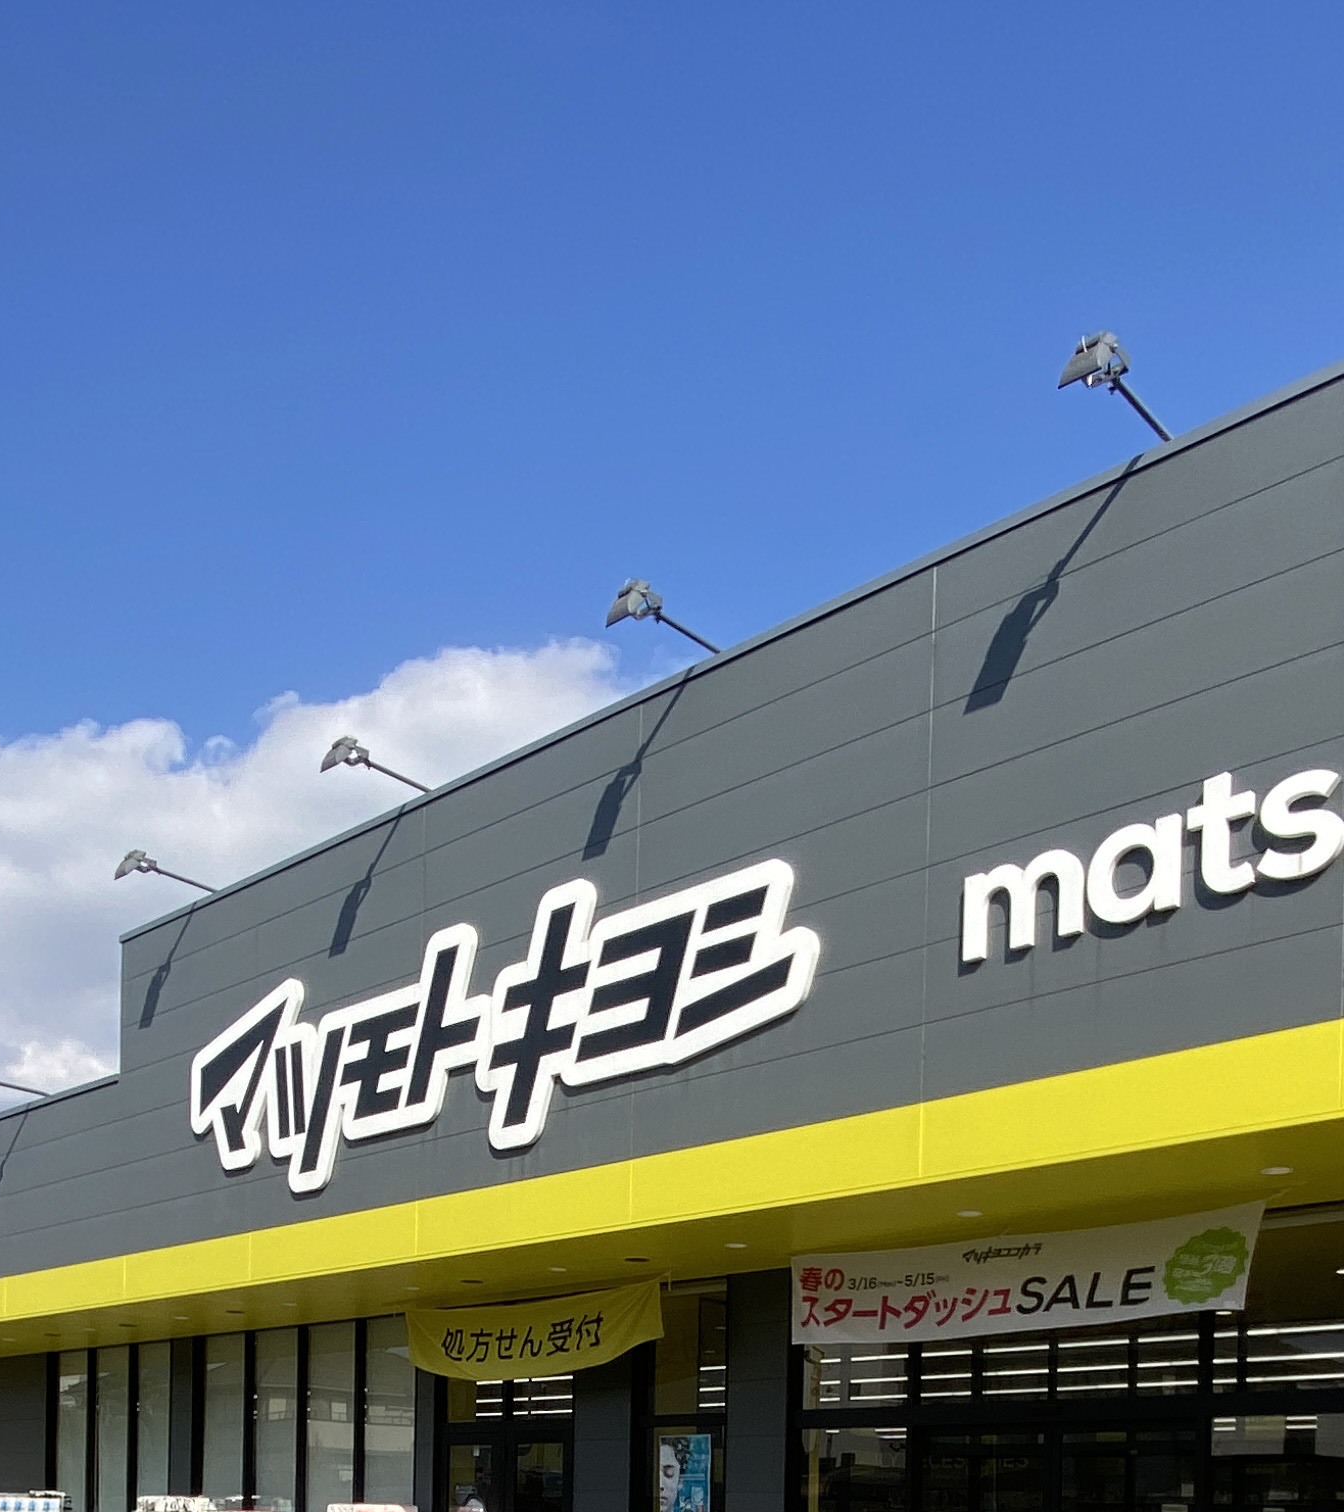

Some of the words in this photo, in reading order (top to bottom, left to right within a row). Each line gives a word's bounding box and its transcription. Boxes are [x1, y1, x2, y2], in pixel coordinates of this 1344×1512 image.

[191, 858, 820, 1193] マツモトキヨシ
[799, 1266, 845, 1292] 春の
[440, 1310, 604, 1363] 処方せん受付
